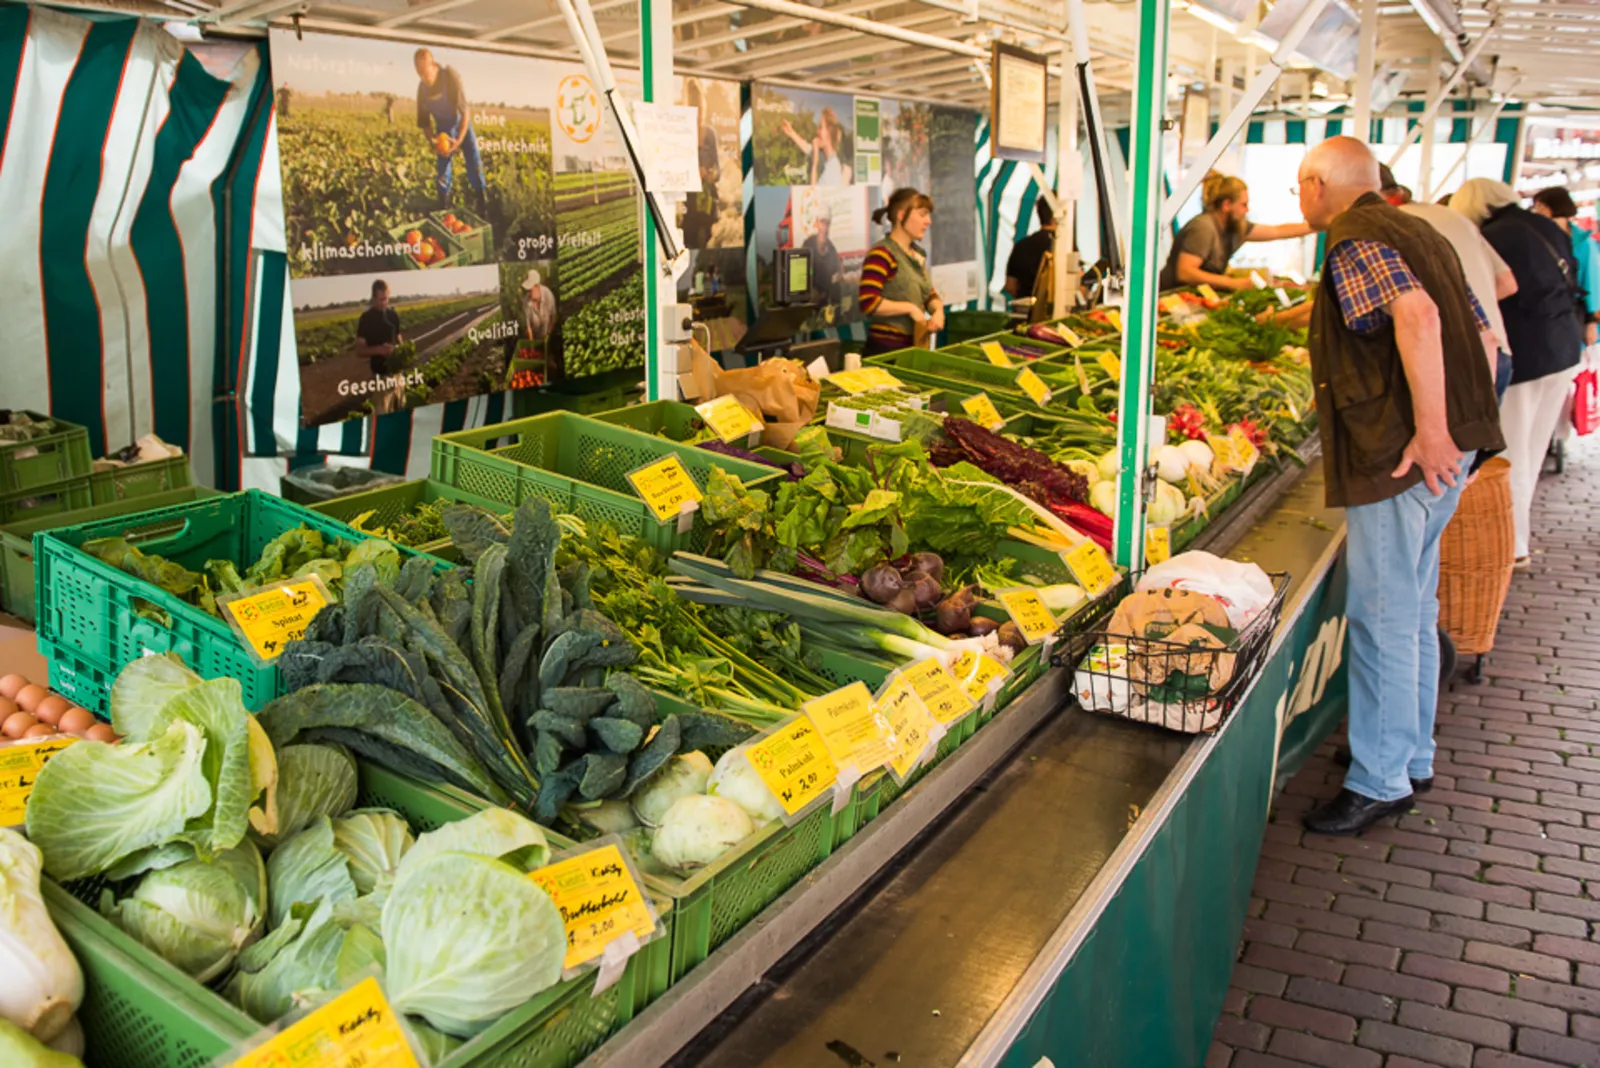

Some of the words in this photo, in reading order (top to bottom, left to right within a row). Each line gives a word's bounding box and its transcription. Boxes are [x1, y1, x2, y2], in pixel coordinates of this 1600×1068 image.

[474, 110, 506, 127] ohne
[476, 136, 548, 153] Gentechnik
[517, 234, 553, 260] große
[557, 231, 602, 247] Vielfalt
[468, 320, 519, 345] Qualität
[337, 368, 424, 396] Geschmack
[271, 613, 304, 628] Spinat
